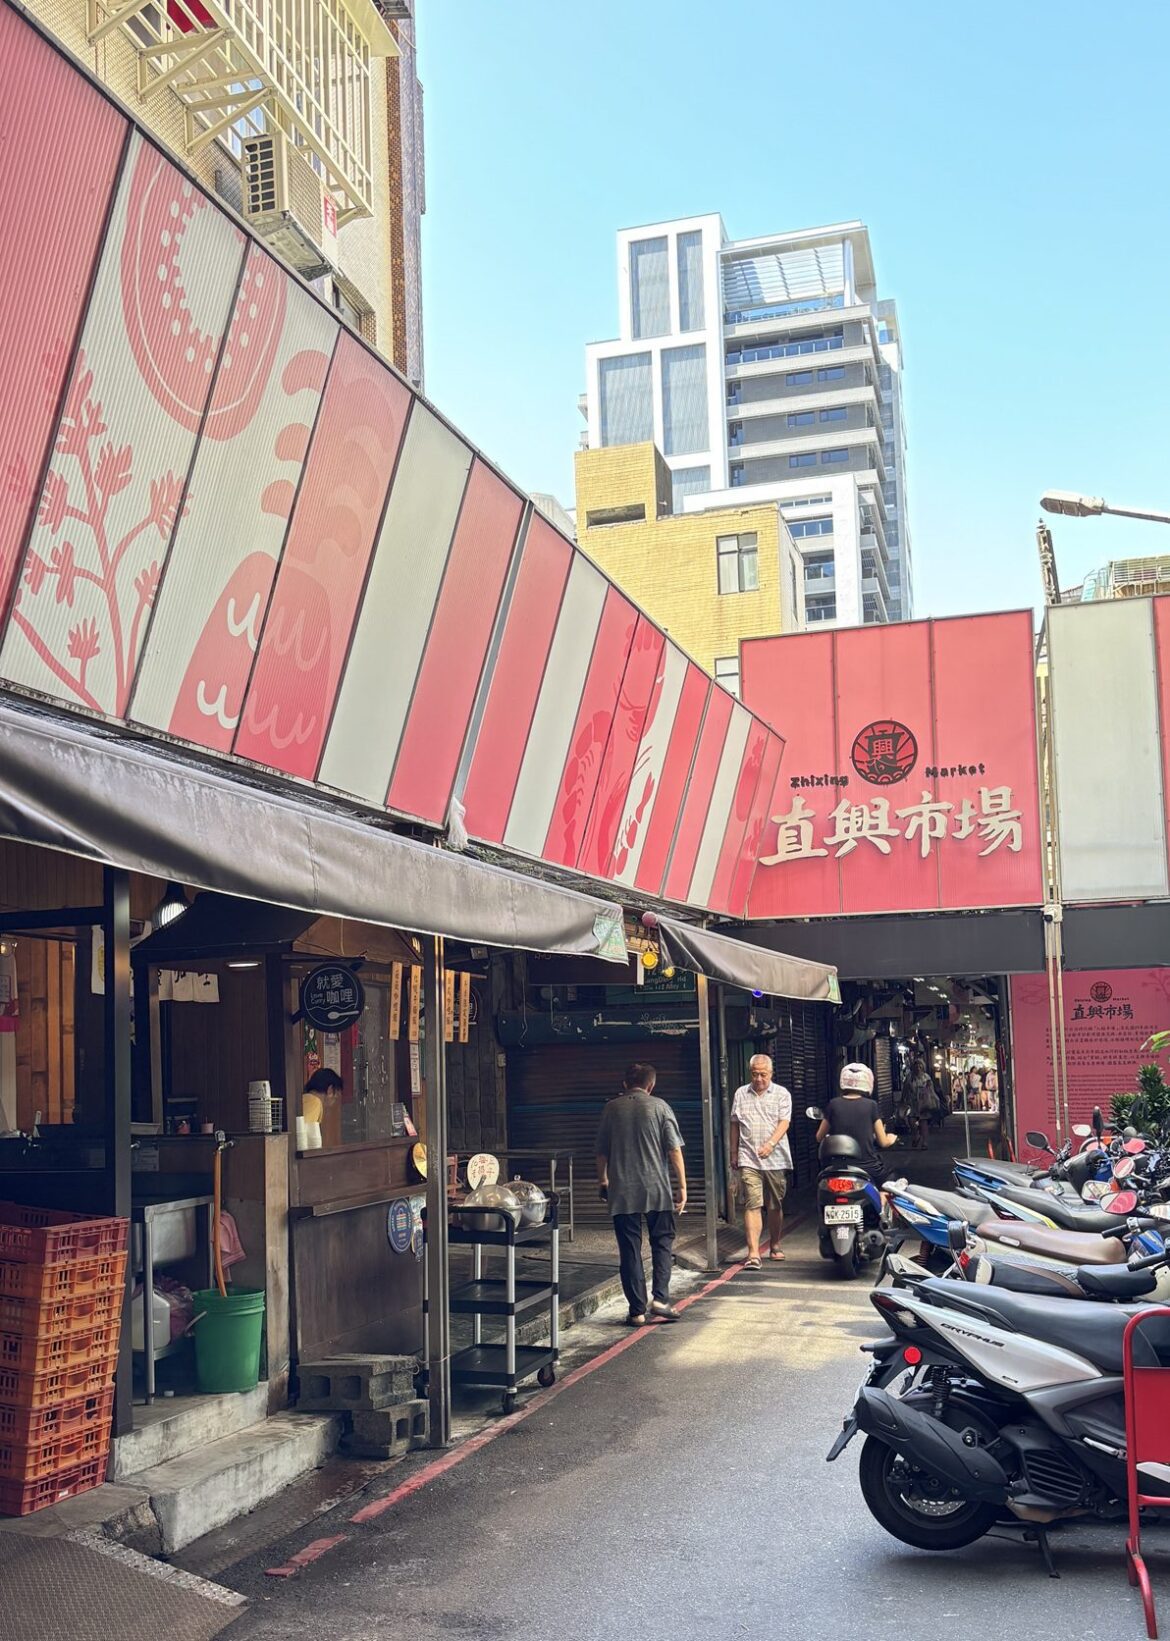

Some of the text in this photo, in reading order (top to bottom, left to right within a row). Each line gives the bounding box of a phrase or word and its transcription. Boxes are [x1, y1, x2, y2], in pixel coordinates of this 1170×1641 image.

[790, 762, 986, 789] Zhixing Market
[758, 785, 1023, 867] 直興市場
[316, 973, 345, 990] 就愛
[326, 988, 355, 1005] 咖哩
[1070, 1004, 1134, 1021] 直興市場
